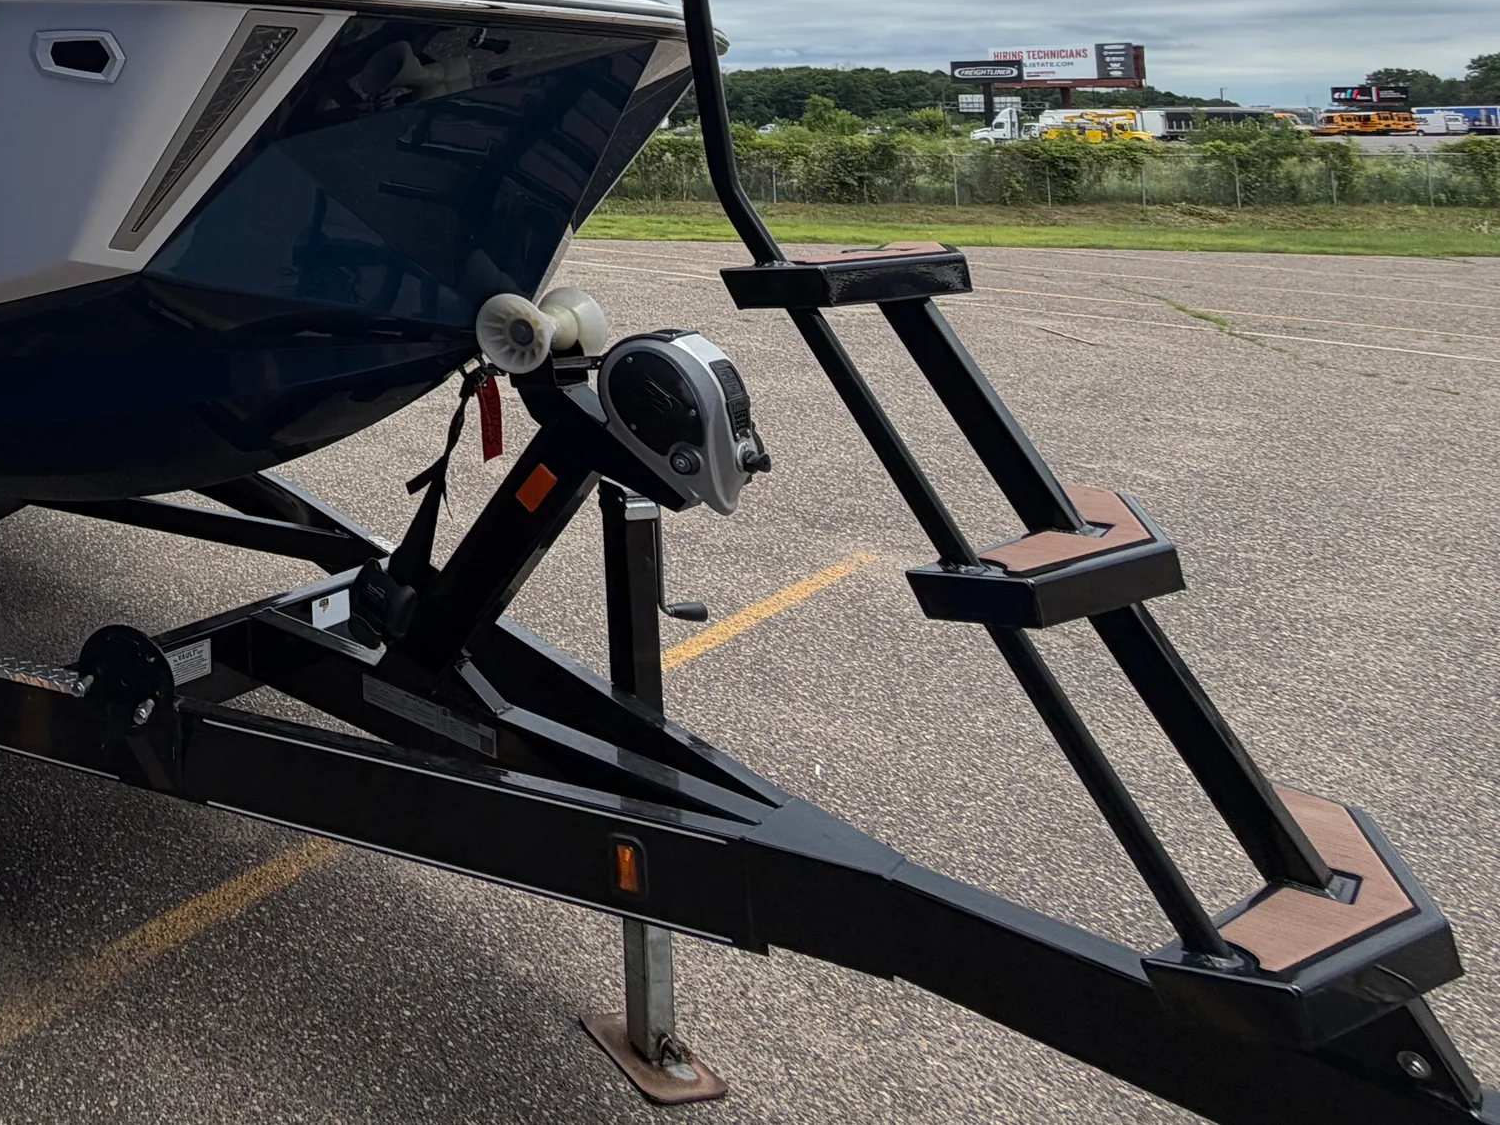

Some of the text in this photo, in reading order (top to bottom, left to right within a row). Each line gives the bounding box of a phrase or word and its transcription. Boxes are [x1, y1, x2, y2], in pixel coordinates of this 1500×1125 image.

[993, 48, 1088, 61] HIRING TECHNICIANS
[960, 68, 1012, 76] FREIGHTLINER
